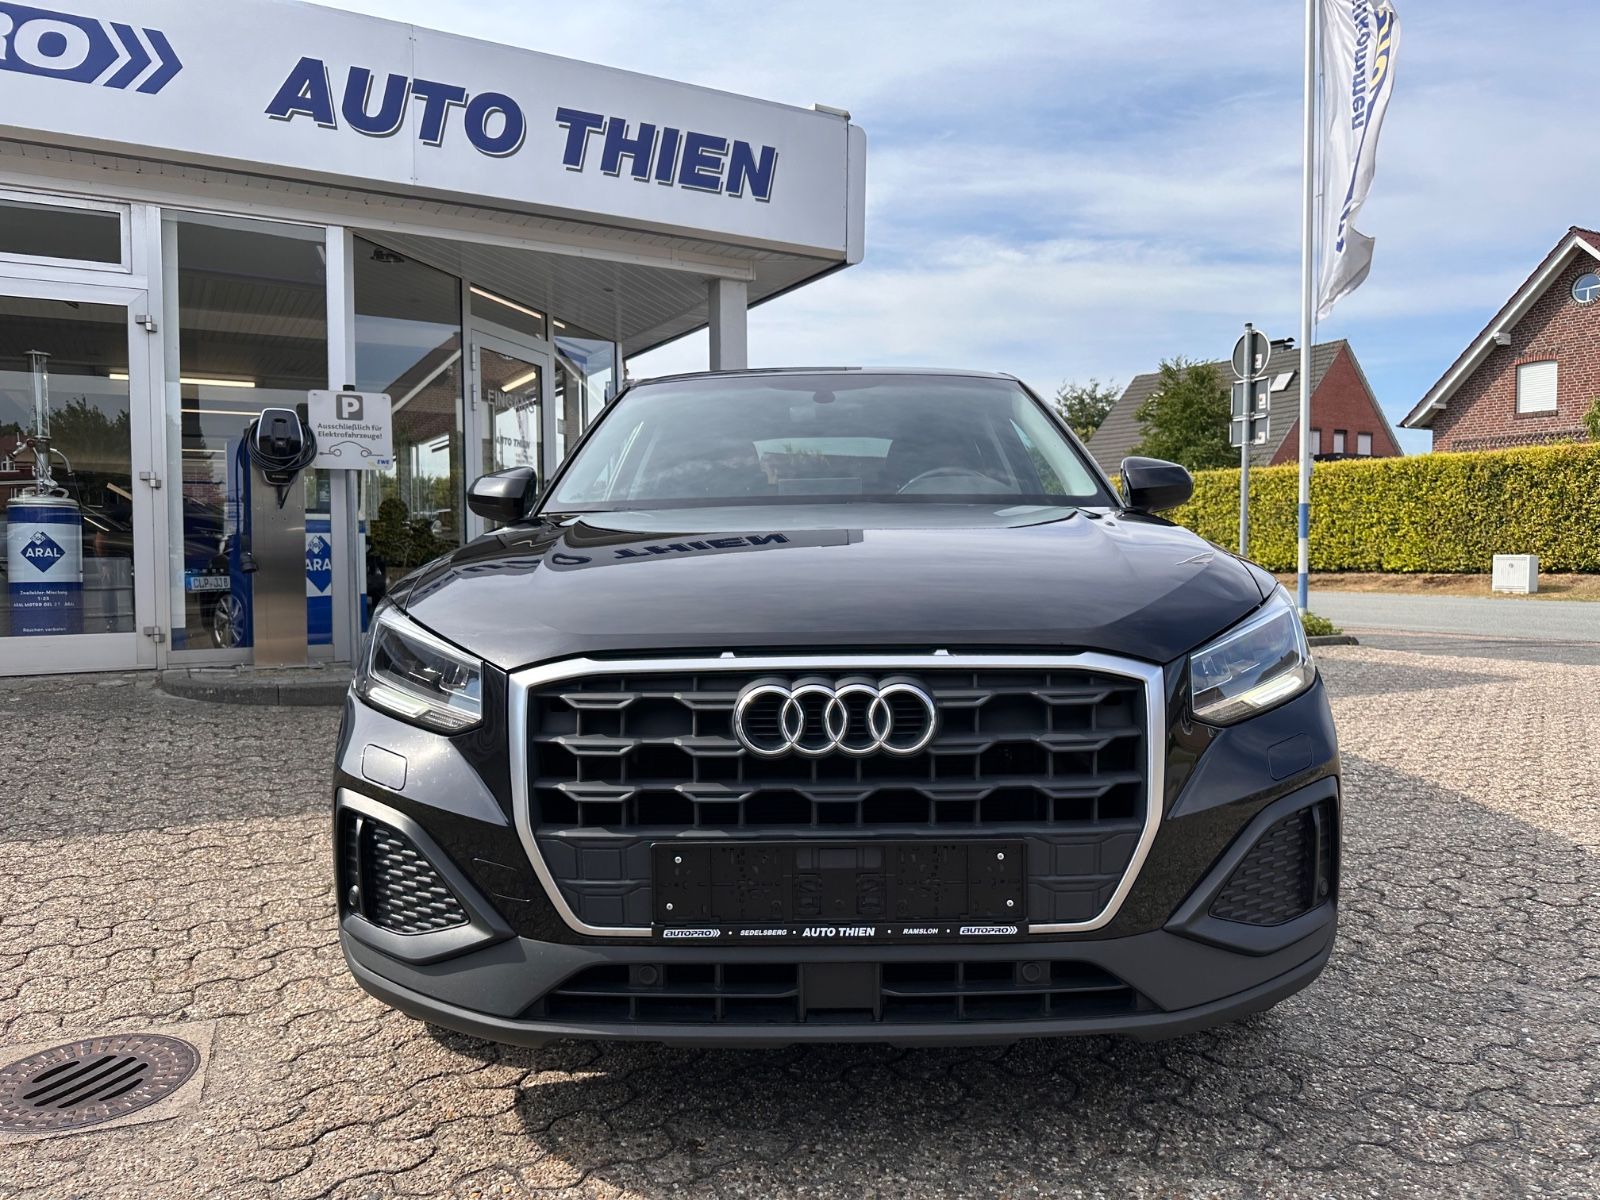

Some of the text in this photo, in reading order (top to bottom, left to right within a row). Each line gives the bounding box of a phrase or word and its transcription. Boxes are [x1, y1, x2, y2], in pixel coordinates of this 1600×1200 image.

[0, 11, 90, 70] O
[264, 56, 778, 202] AUTO THIEN
[341, 396, 360, 418] P
[317, 423, 371, 431] Ausschließlich
[317, 430, 383, 441] Elektrofahrzeuge!
[25, 547, 61, 558] ARAL
[305, 558, 332, 571] ARA
[802, 927, 836, 937] AUTO
[838, 927, 876, 937] THIEN
